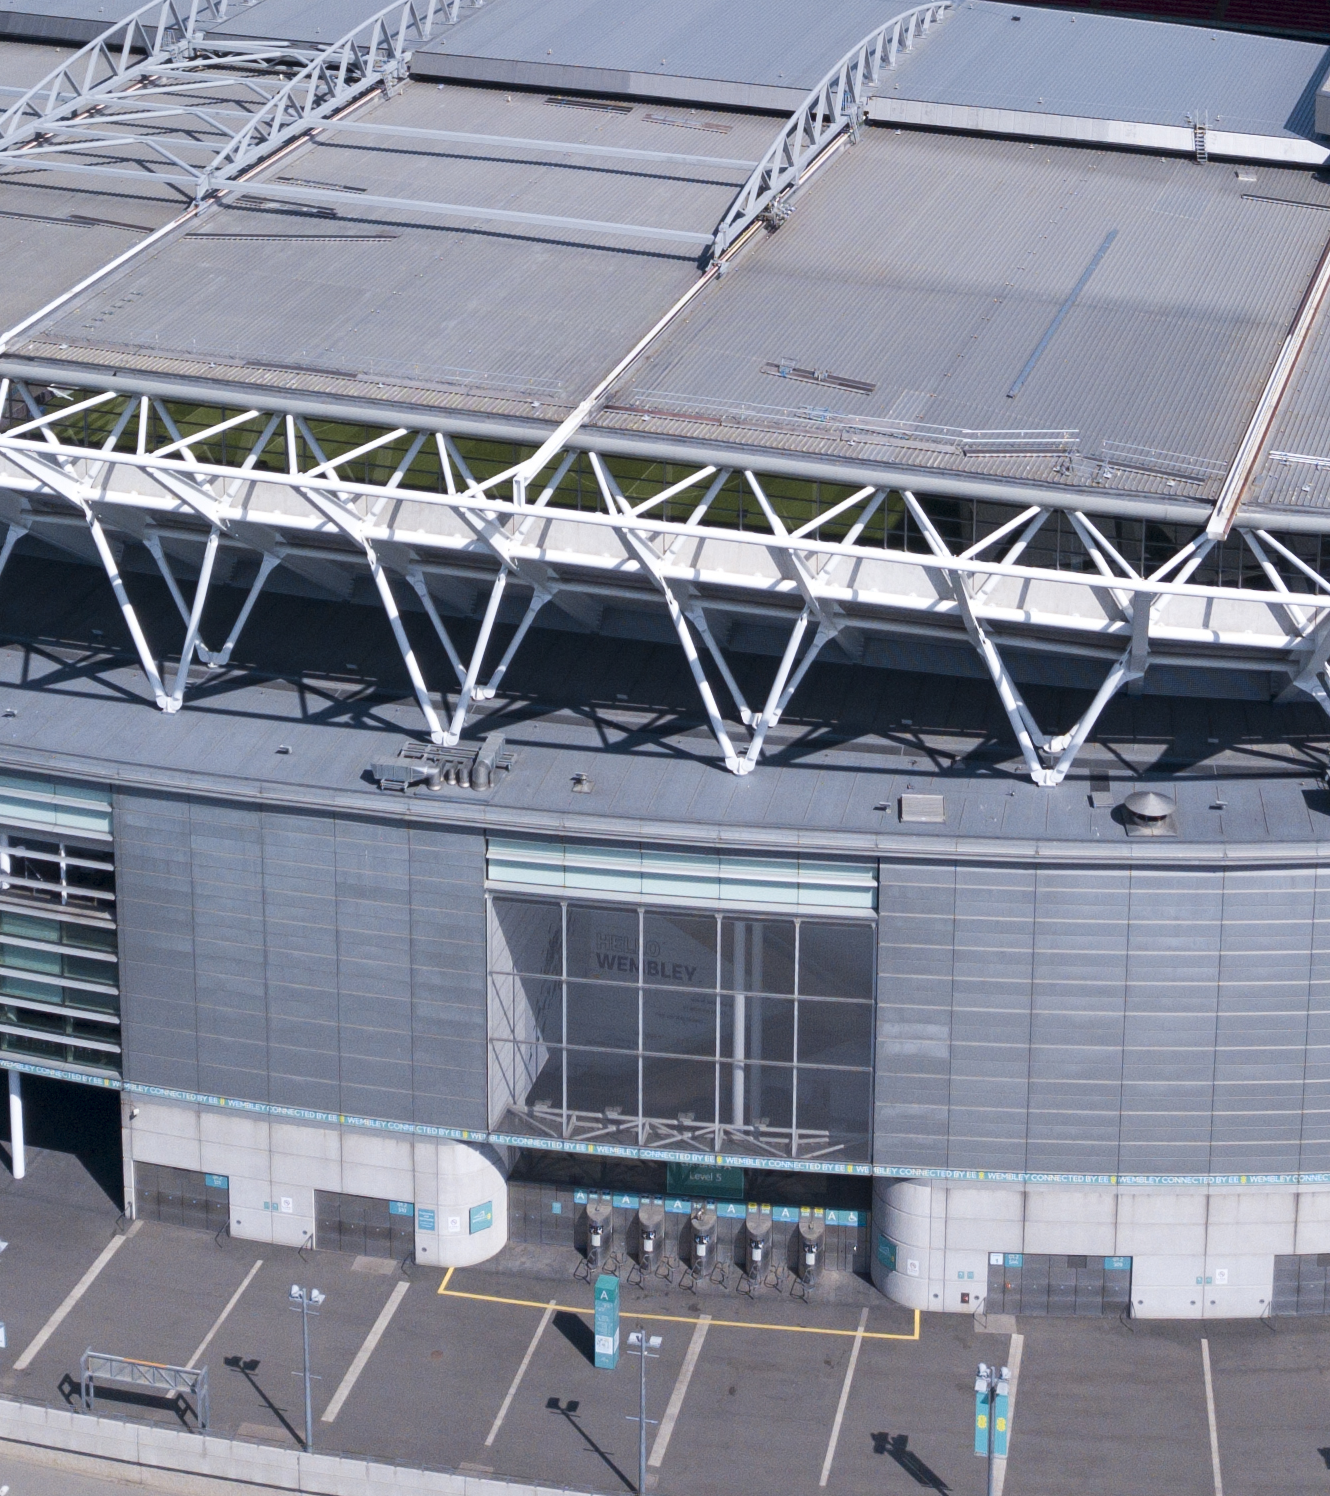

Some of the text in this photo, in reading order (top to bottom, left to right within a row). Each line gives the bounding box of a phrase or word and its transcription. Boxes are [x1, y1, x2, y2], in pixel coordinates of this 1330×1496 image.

[596, 952, 697, 982] WEMBLEY
[0, 1059, 103, 1085] WEMBLEY CONNECTED BY EE
[149, 1085, 197, 1101] CONNECTED
[197, 1093, 208, 1103] BY
[208, 1095, 218, 1105] EE
[227, 1099, 338, 1122] WEMBLEY CONNECTED BY EE
[347, 1116, 461, 1138] WEMBLEY CONNECTED BY EE
[511, 1136, 563, 1150] CONNECTED
[563, 1141, 576, 1151] BY
[576, 1143, 587, 1152] EE
[596, 1145, 715, 1163] WEMBLEY CONNECTED BY EE
[725, 1157, 768, 1167] WEMBLEY
[768, 1159, 821, 1171] CONNECTED
[821, 1162, 835, 1171] BY
[834, 1163, 846, 1172] EE
[690, 1171, 713, 1182] Level
[899, 1167, 952, 1178] CONNECTED
[952, 1169, 966, 1178] BY
[966, 1170, 977, 1179] EE
[987, 1172, 1109, 1184] WEMBLEY CONNECTED BY EE
[1249, 1173, 1292, 1183] WEMBLEY
[1118, 1175, 1239, 1184] WEMBLEY CONNECTED BY EE
[576, 1191, 585, 1200] A
[621, 1195, 630, 1204] A
[673, 1200, 682, 1209] A
[727, 1204, 736, 1214] A
[781, 1208, 790, 1218] A
[828, 1211, 837, 1221] A
[600, 1290, 609, 1301] A
